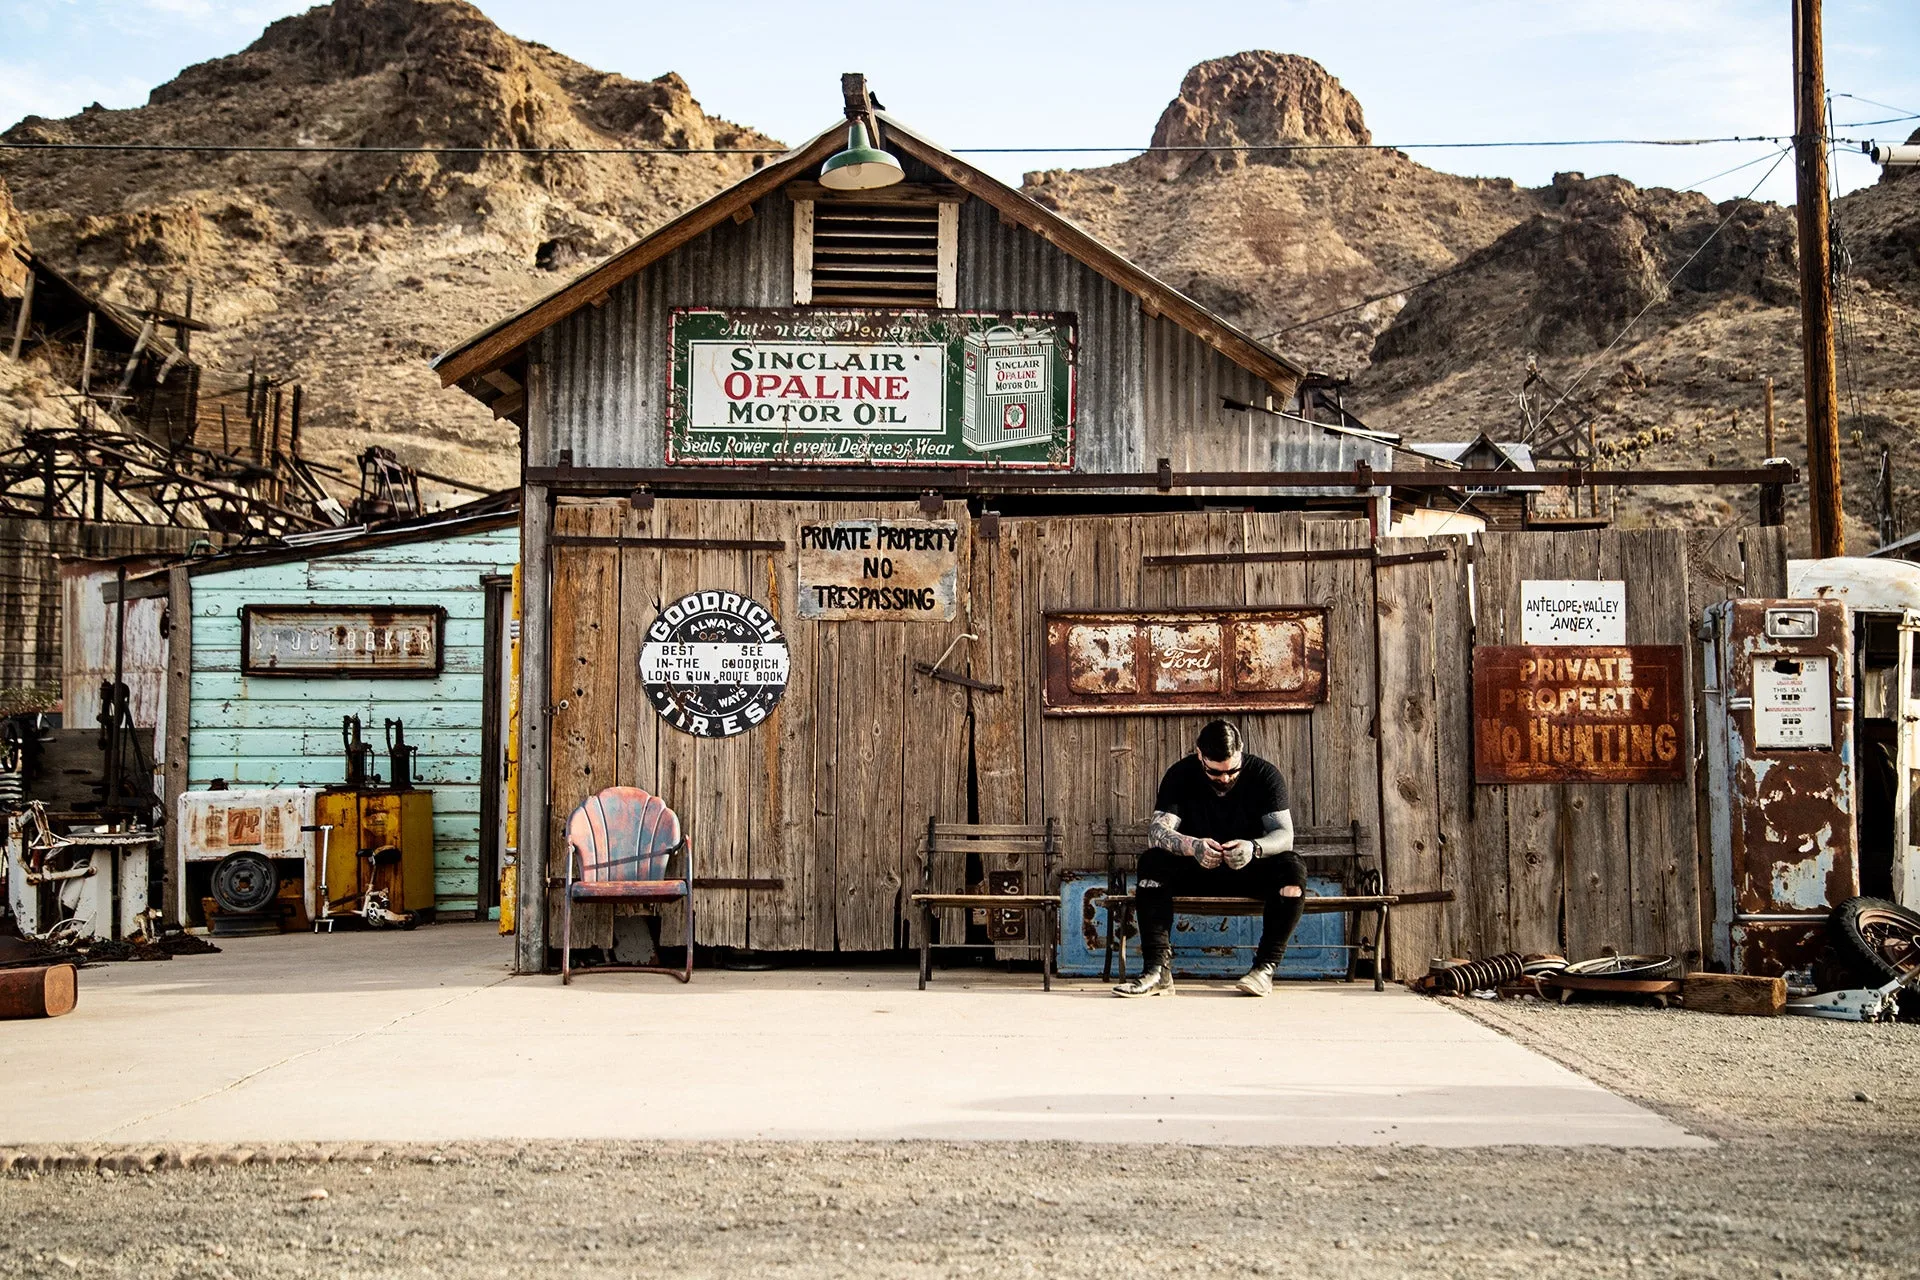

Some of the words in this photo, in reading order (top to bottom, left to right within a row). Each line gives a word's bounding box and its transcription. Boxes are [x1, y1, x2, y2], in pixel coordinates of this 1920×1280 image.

[731, 347, 906, 371] SINCLAIR
[995, 360, 1040, 370] SINCLAIR
[723, 371, 910, 400] OPALINE
[995, 381, 1023, 391] MOTOR
[1024, 380, 1038, 389] OIL
[997, 370, 1037, 382] OPALINE
[727, 402, 843, 424] MOTOR
[853, 402, 908, 425] OIL
[681, 435, 721, 454] Seals
[724, 437, 768, 454] Power
[772, 438, 788, 454] at
[793, 442, 836, 458] every
[839, 437, 892, 458] Degree
[895, 438, 912, 459] of
[915, 438, 954, 456] Wear
[800, 526, 872, 550] PRIVATE
[877, 526, 958, 552] PROPERTY
[863, 557, 893, 579] NO
[812, 585, 935, 610] TRESPASSING
[1526, 600, 1578, 612] ANTELOPE
[1582, 600, 1619, 612] VALLEY
[650, 591, 781, 643] GOODRICH
[690, 618, 745, 636] ALWAYS
[1552, 617, 1594, 629] ANNEX
[662, 645, 695, 656] BEST
[741, 646, 763, 656] SEE
[1160, 647, 1211, 668] Ford
[722, 658, 779, 669] GOODRICH
[1519, 658, 1634, 681] PRIVATE
[648, 671, 680, 681] LONG
[720, 671, 749, 681] ROUTE
[756, 671, 783, 682] BOOK
[718, 687, 748, 708] WAYS
[1500, 687, 1653, 712] PROPERTY
[1481, 717, 1522, 763] NO
[1529, 717, 1677, 763] HUNTING
